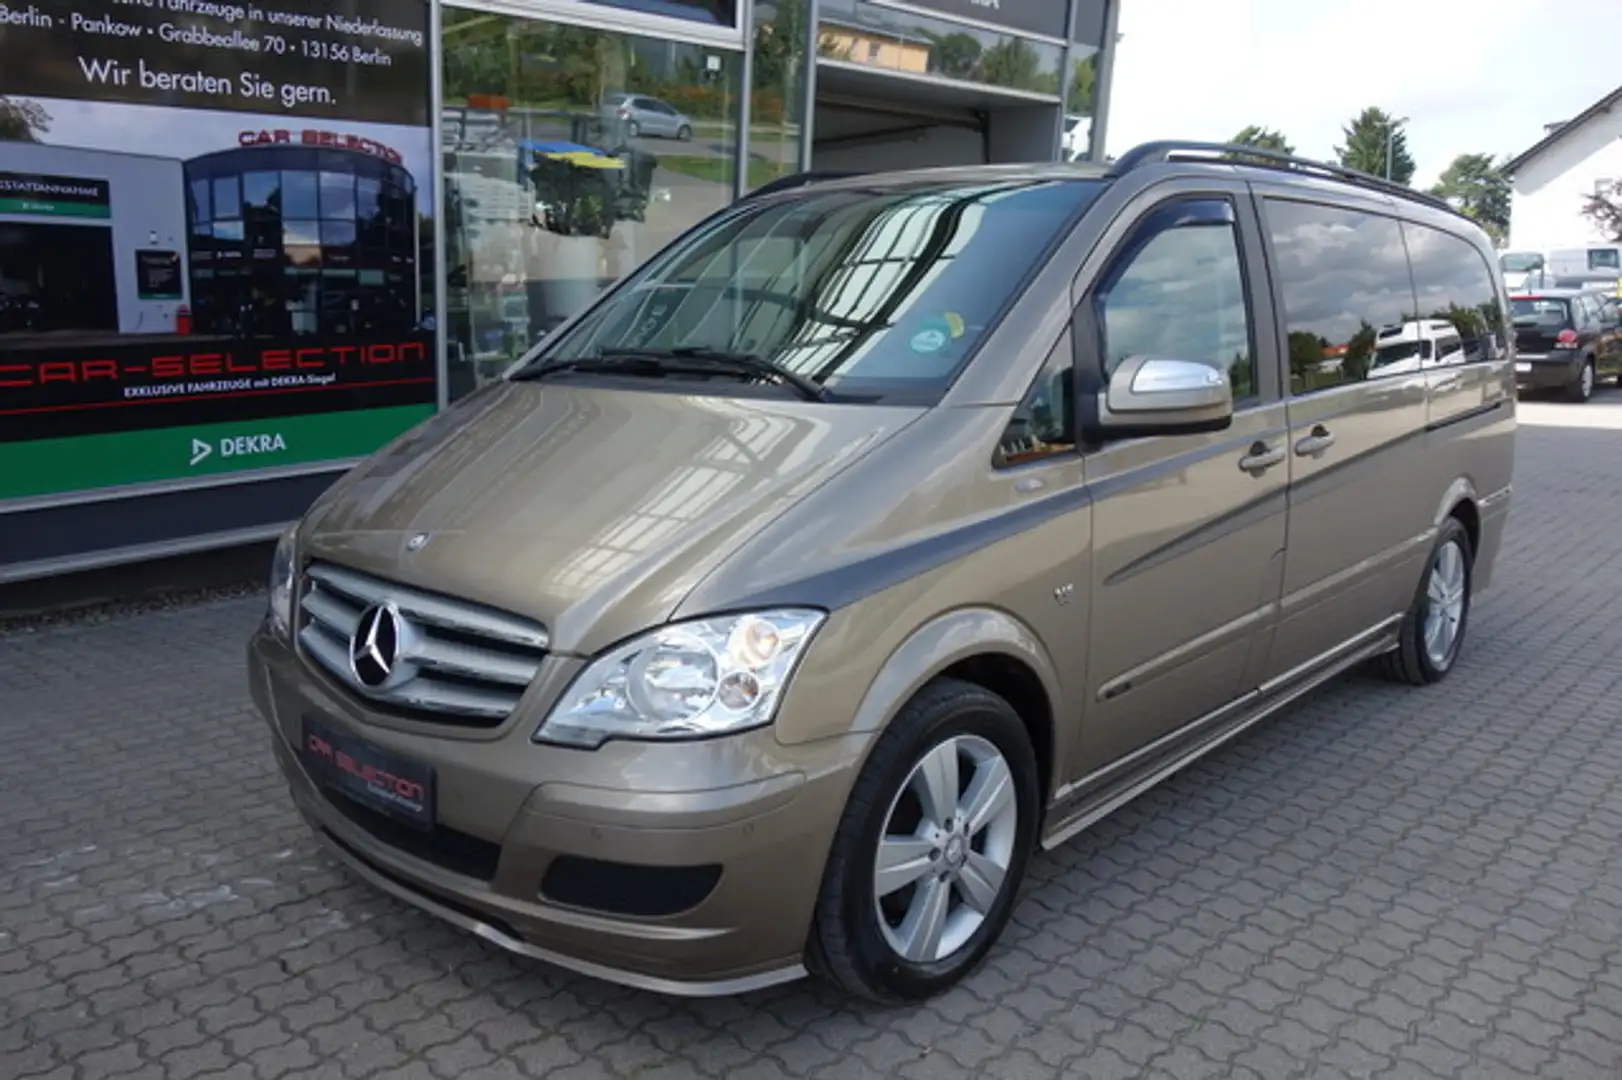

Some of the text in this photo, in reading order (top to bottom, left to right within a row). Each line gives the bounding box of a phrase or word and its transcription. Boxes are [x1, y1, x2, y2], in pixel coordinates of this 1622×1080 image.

[0, 4, 392, 67] Berlin Pankow Grabbeallee 70 13156 Berlin
[248, 3, 264, 20] in
[268, 11, 322, 29] unserer
[326, 14, 423, 47] Niederlassung
[78, 55, 337, 108] Wir beraten Sie gern.
[124, 382, 186, 398] EXKLUSIVE
[187, 378, 252, 393] FAHRZEUGE
[253, 378, 270, 388] mit
[220, 432, 287, 457] DEKRA
